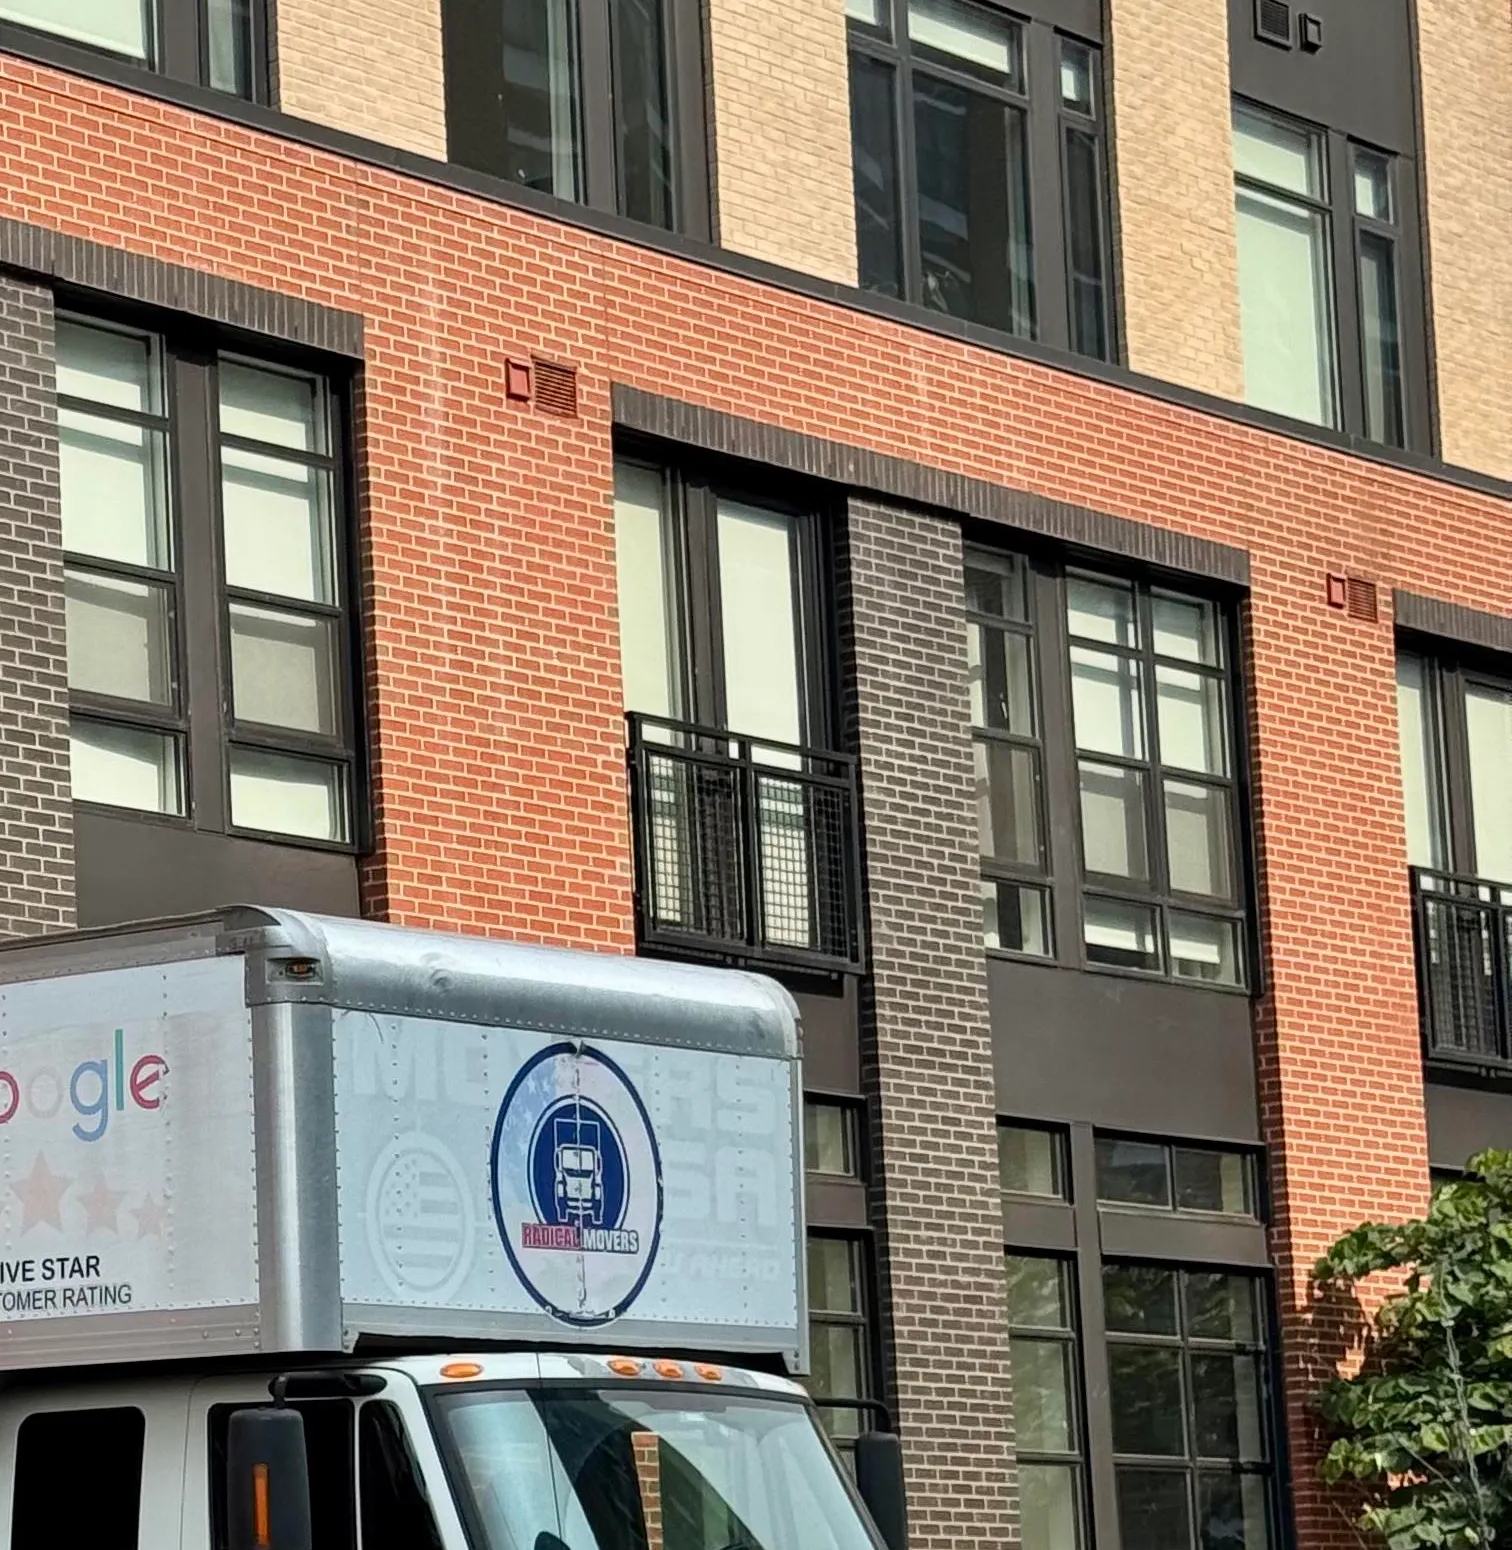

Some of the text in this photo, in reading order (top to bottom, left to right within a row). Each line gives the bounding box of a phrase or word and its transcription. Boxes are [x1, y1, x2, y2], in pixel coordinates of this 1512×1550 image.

[583, 1227, 639, 1252] MOVERS
[41, 1255, 101, 1281] STAR
[62, 1284, 132, 1309] RATING
